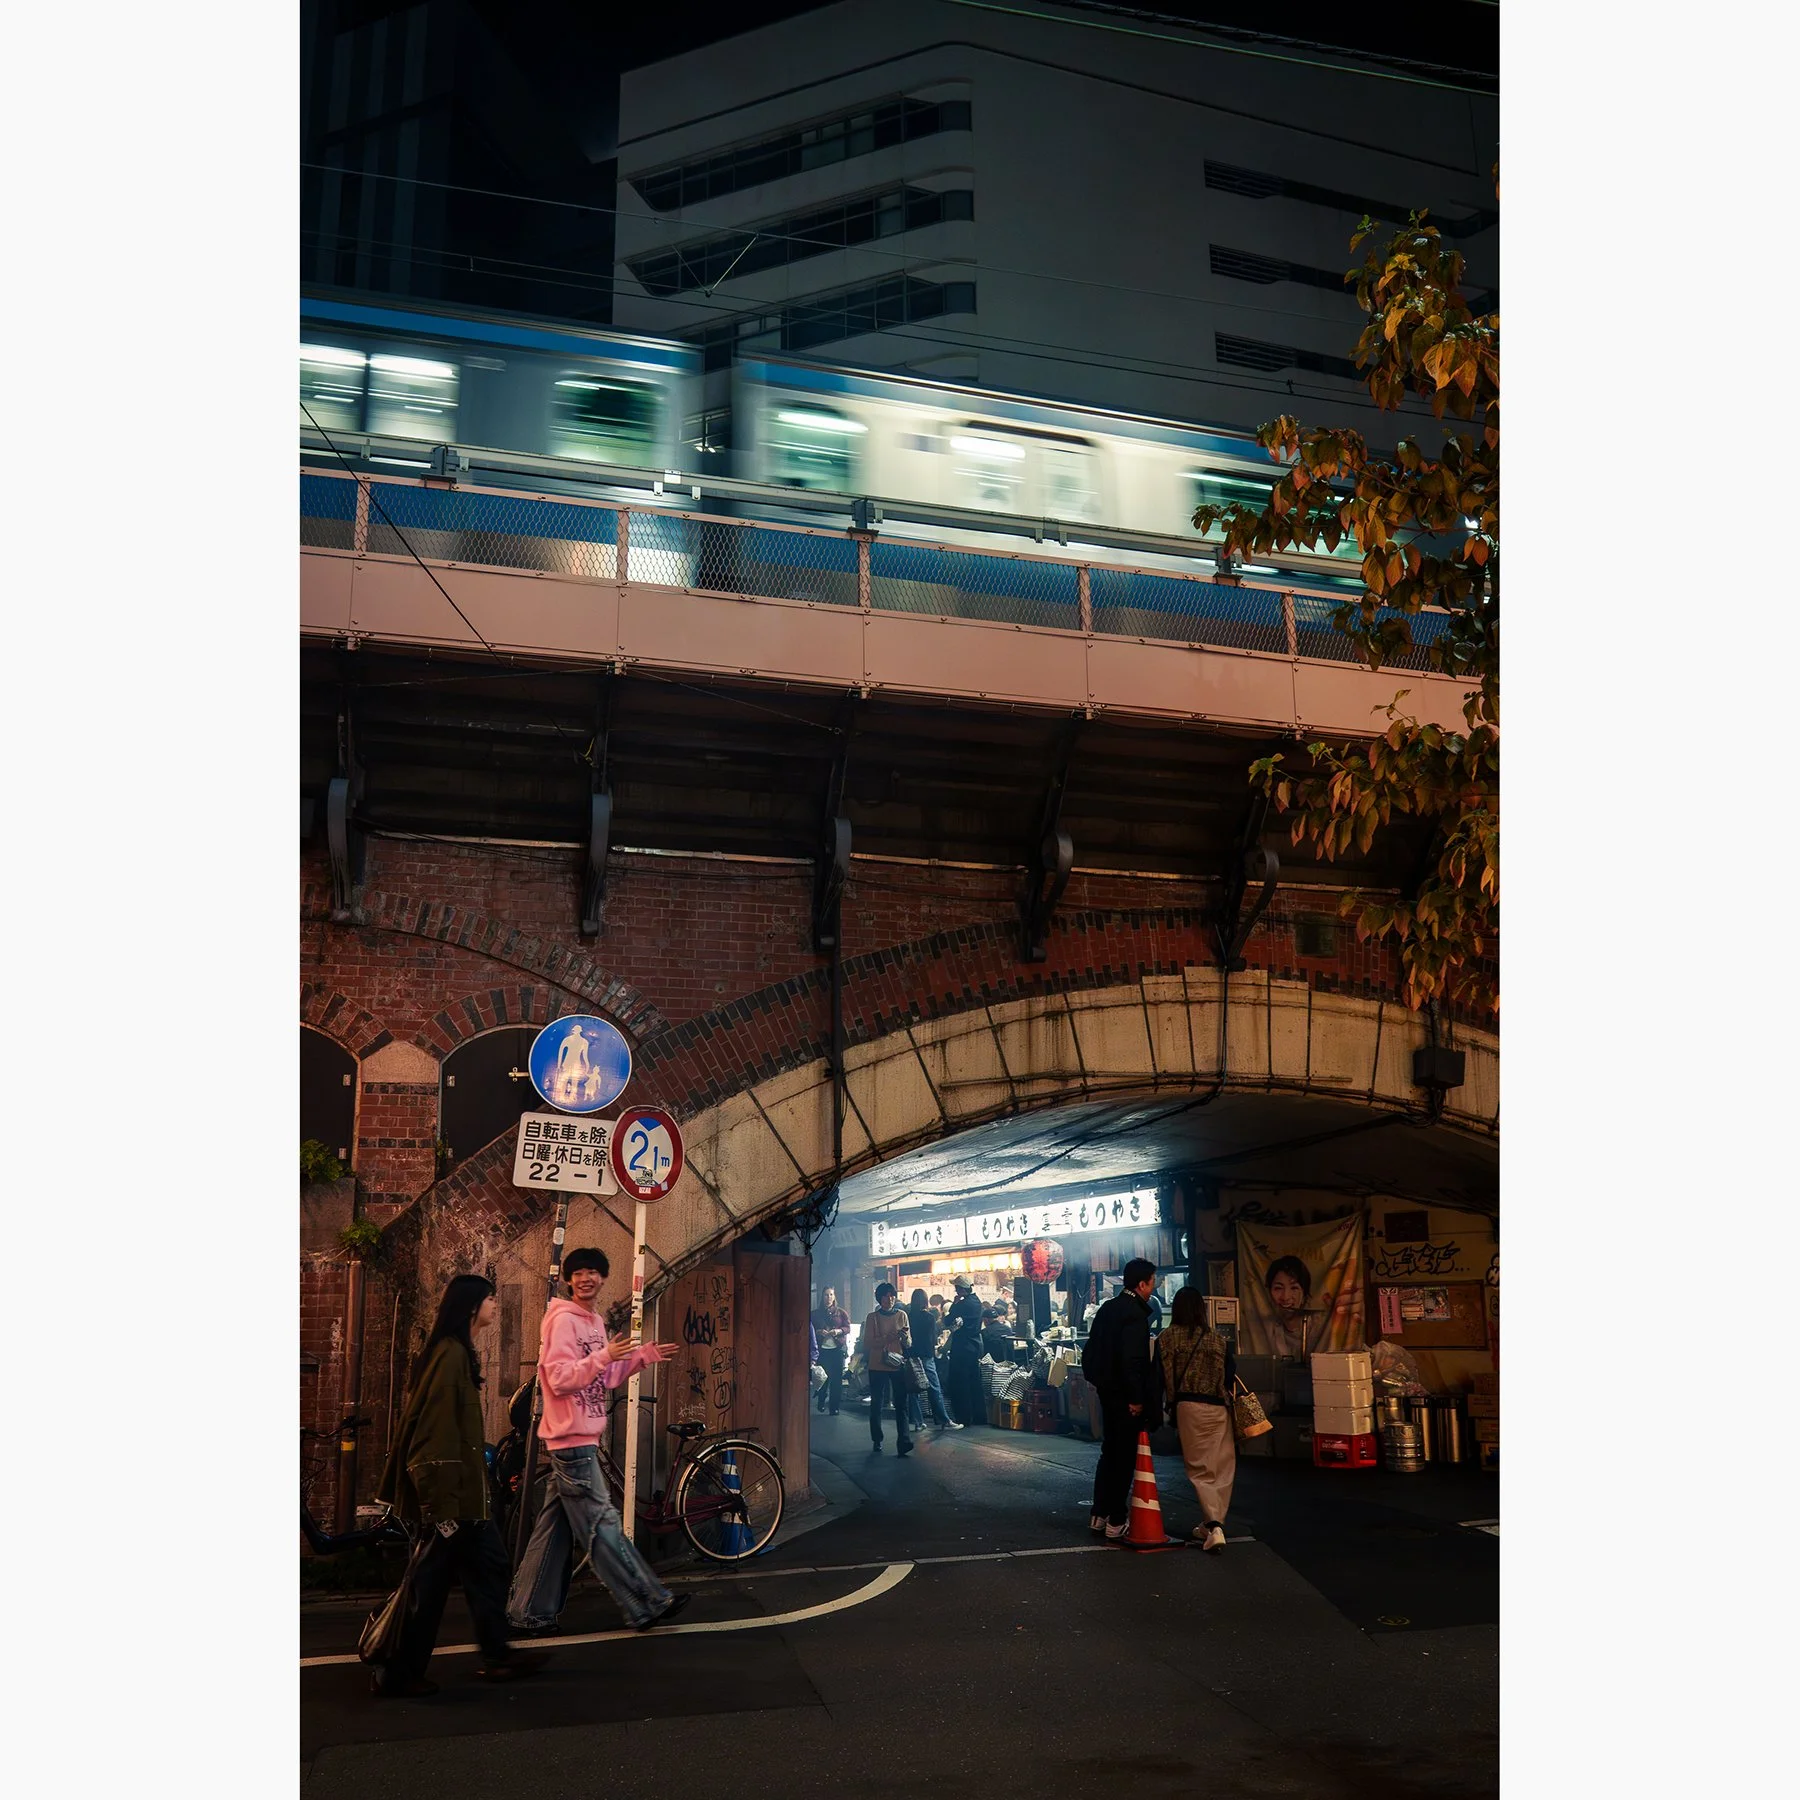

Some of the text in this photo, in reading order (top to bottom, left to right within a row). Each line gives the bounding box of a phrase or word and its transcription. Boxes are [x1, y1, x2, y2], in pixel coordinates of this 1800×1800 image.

[525, 1120, 611, 1145] 自転車を除
[522, 1143, 611, 1167] 日曜・休日を除
[1079, 1195, 1140, 1228] もつやき
